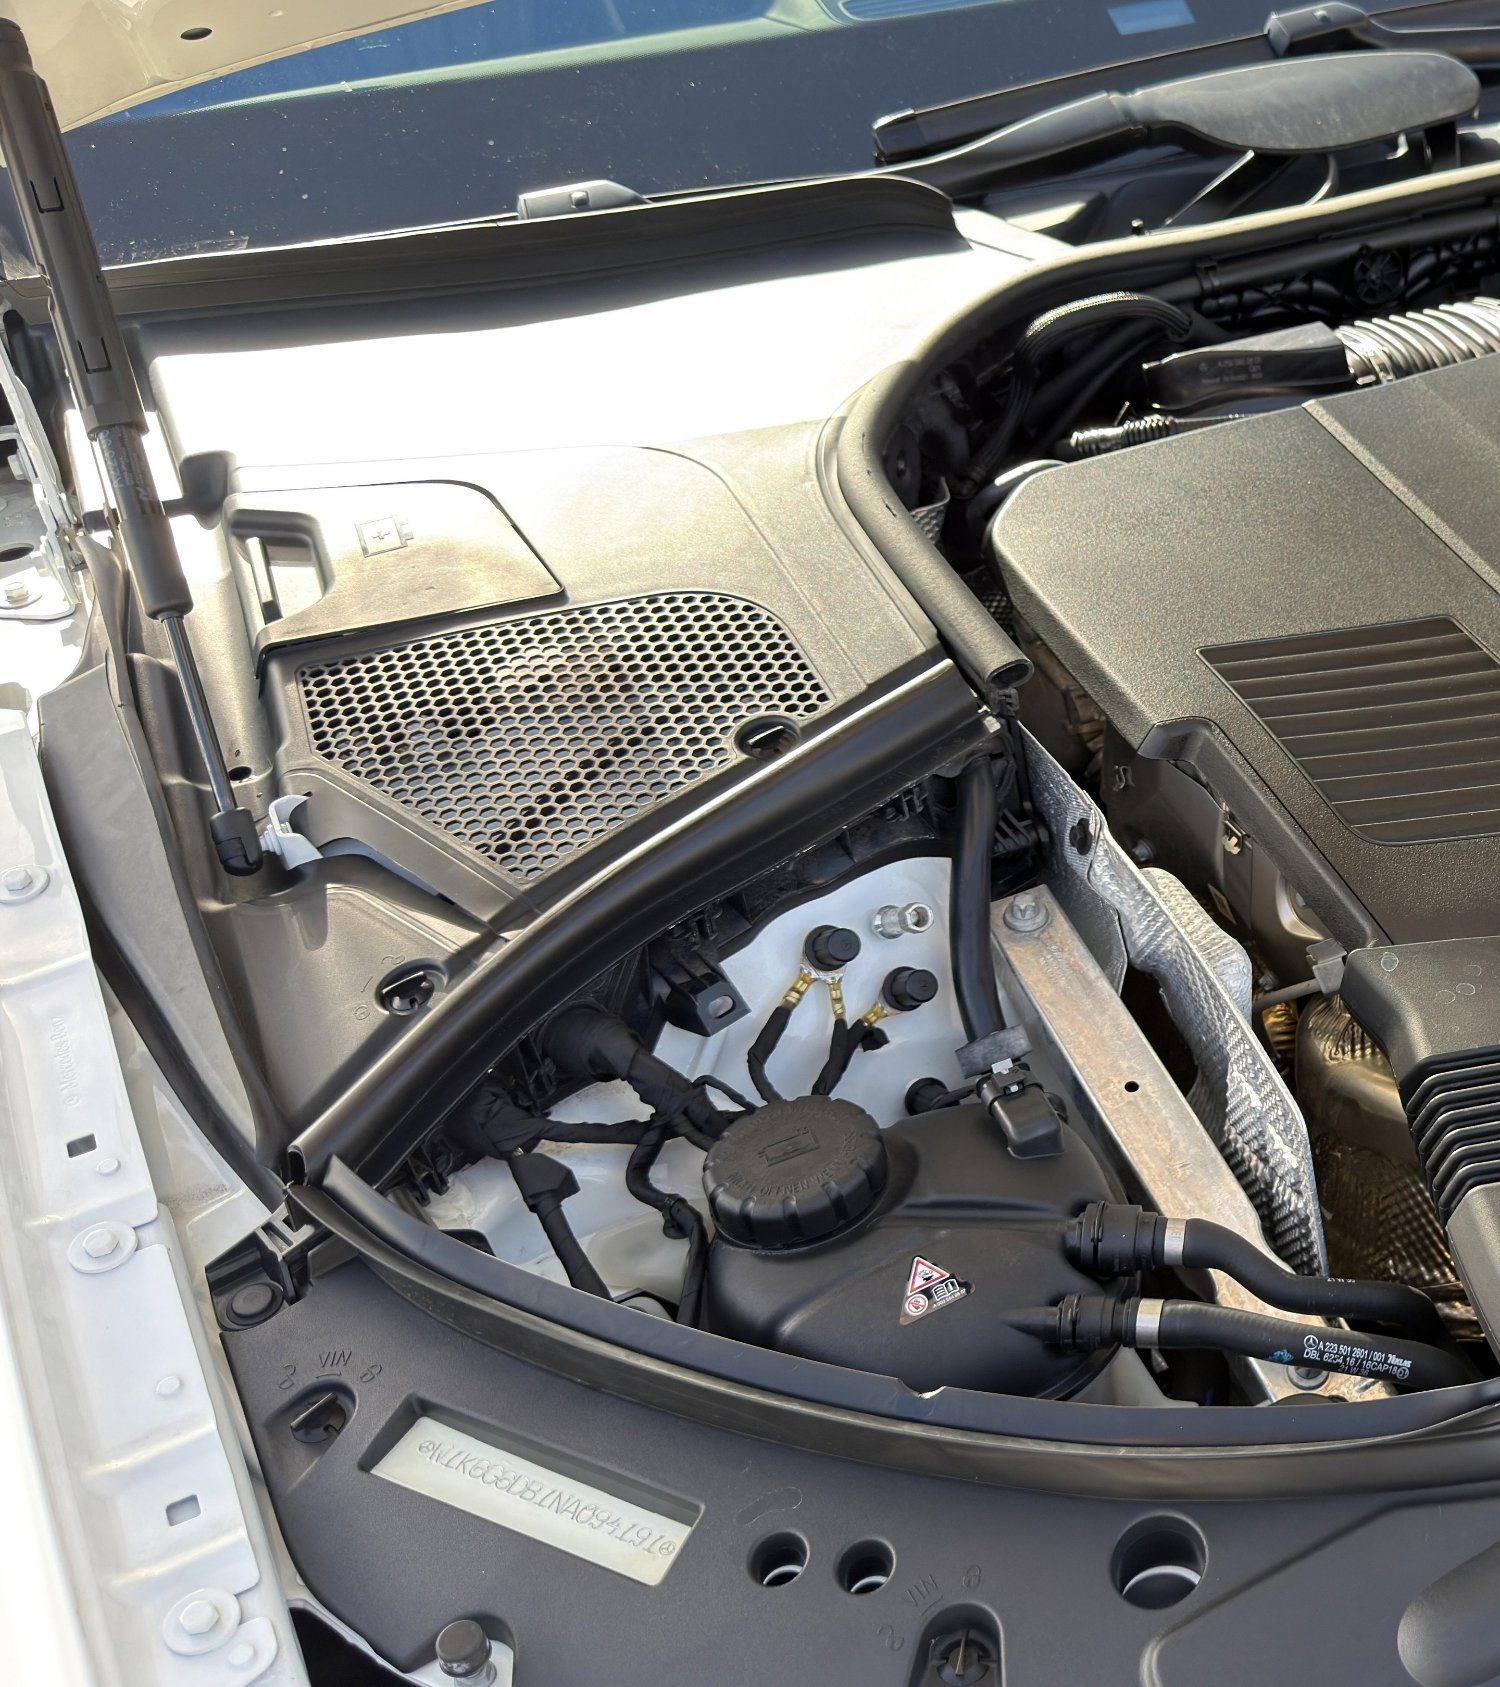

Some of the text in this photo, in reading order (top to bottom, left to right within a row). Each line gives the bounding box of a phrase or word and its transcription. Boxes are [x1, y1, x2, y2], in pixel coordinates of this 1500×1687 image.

[319, 1349, 352, 1369] VIN
[1303, 1348, 1321, 1361] DBL
[1317, 1341, 1325, 1351] A
[1325, 1342, 1338, 1353] 223
[1339, 1345, 1351, 1356] 501
[1352, 1347, 1369, 1360] 2601
[1373, 1351, 1386, 1362] 001
